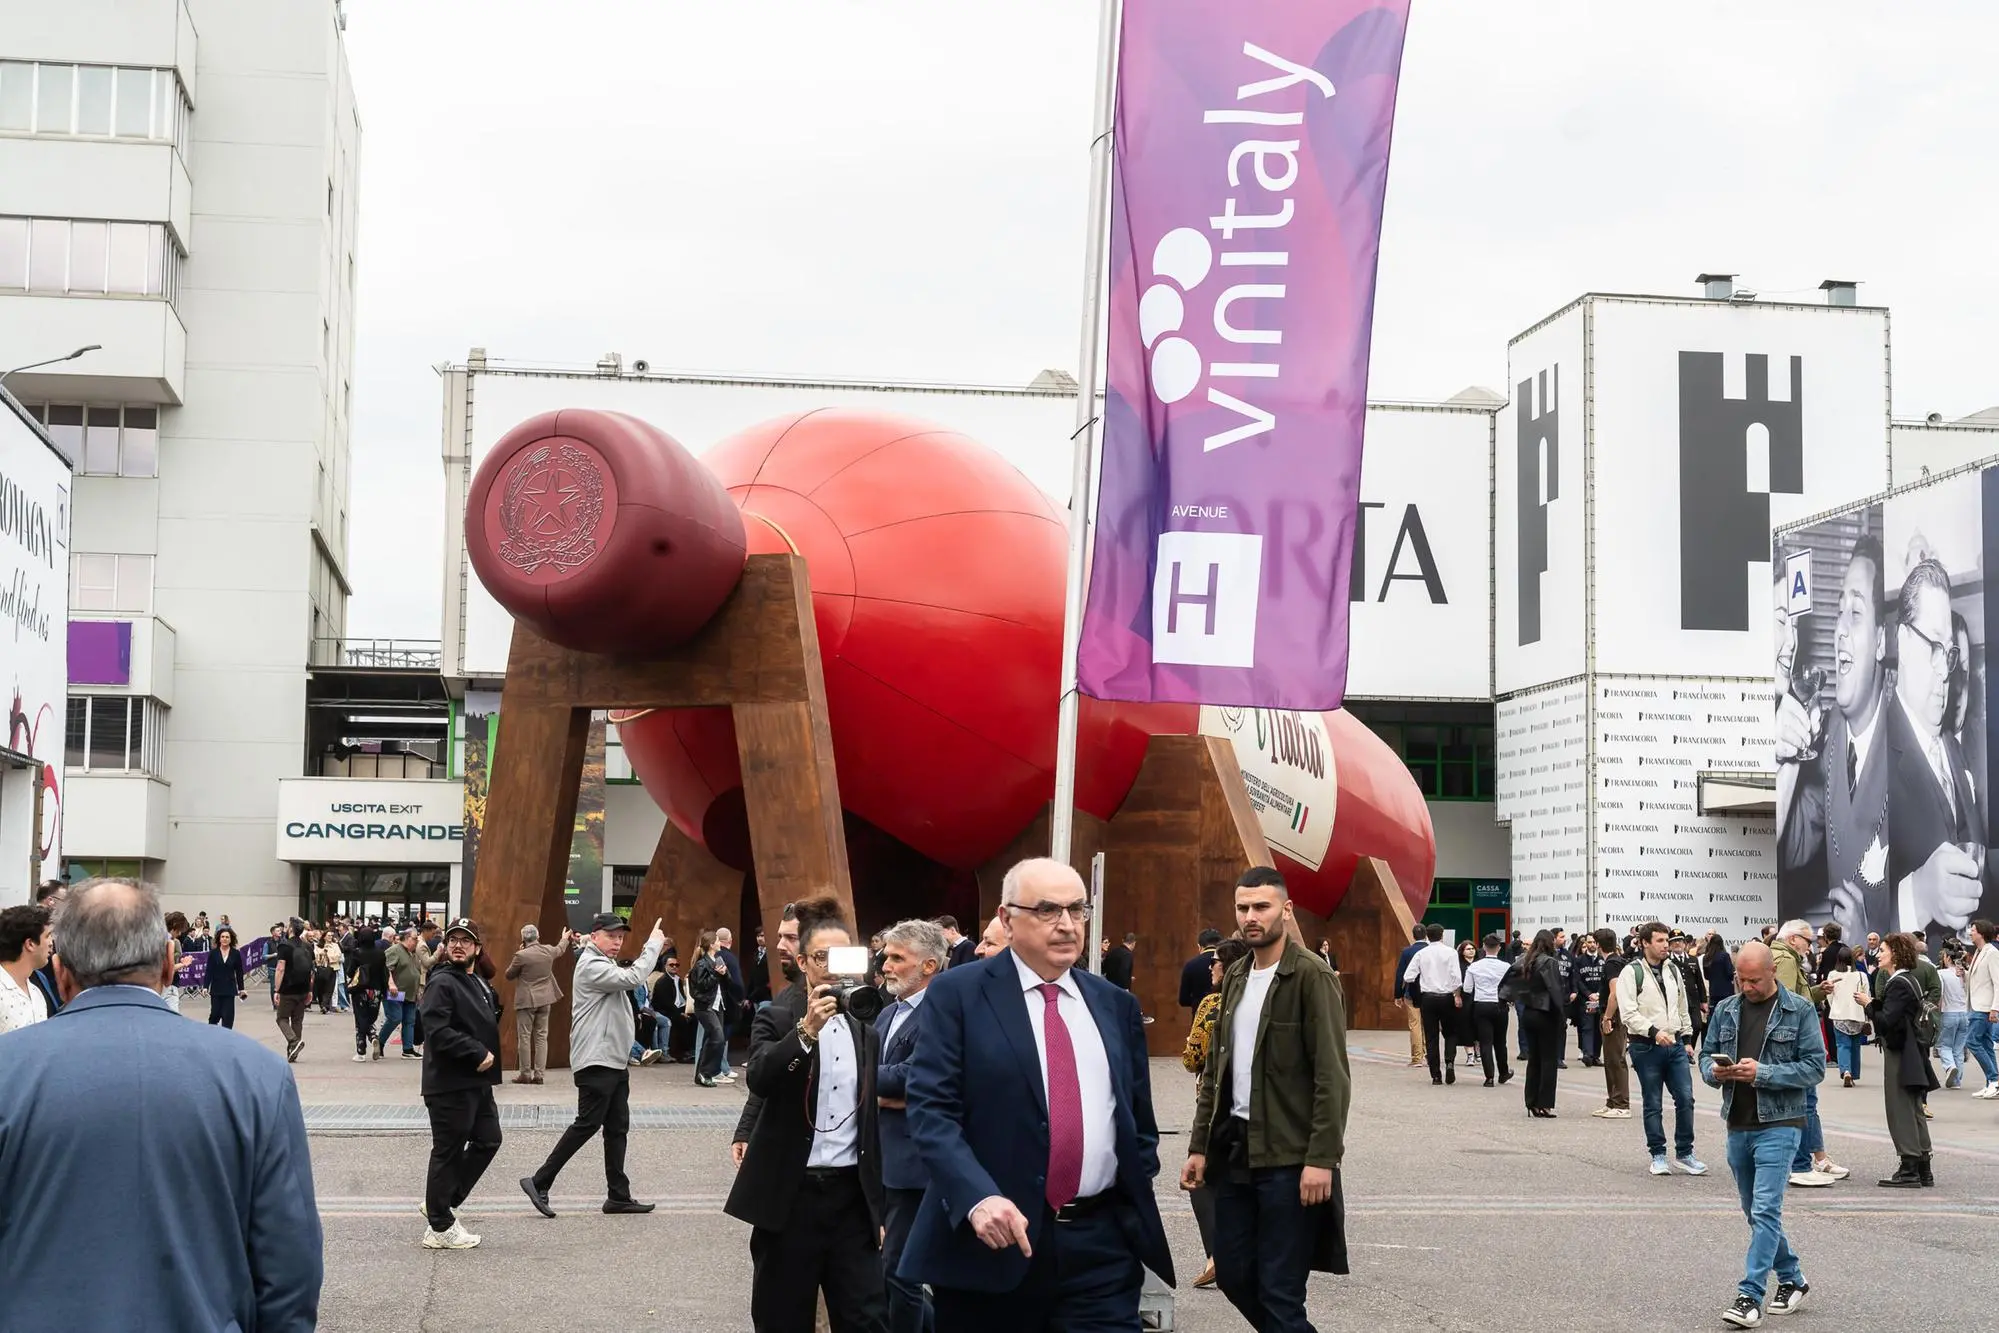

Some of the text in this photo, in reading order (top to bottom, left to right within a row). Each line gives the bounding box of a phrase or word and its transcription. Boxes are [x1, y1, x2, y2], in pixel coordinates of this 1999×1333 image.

[1203, 41, 1336, 453] vinitaly
[1171, 505, 1228, 519] AVENUE
[1791, 570, 1807, 599] A
[0, 567, 18, 618] nd
[1167, 561, 1219, 635] H
[1597, 711, 1622, 719] IACORTA
[1748, 738, 1776, 746] FRANCIA
[1597, 756, 1623, 764] IACORTA
[331, 803, 423, 814] USCITA EXIT
[1598, 801, 1623, 809] IACORTA
[286, 822, 464, 841] CANGRANDE
[1612, 825, 1658, 833] FRANCIACORTA
[1681, 826, 1727, 834] FRANCIACORTA
[1598, 846, 1624, 854] IACORTA
[1647, 848, 1693, 856] FRANCIACORTA
[1716, 849, 1761, 857] FRANCIACORTA
[1612, 869, 1658, 877] FRANCIACORTA
[1681, 871, 1727, 879] FRANCIACORTA
[1476, 884, 1499, 892] CASSA
[1647, 893, 1693, 901] FRANCIACORTA
[1716, 894, 1762, 902] FRANCIACORTA
[1682, 916, 1728, 924] FRANCIACORTA
[1751, 917, 1777, 925] FRANCIA
